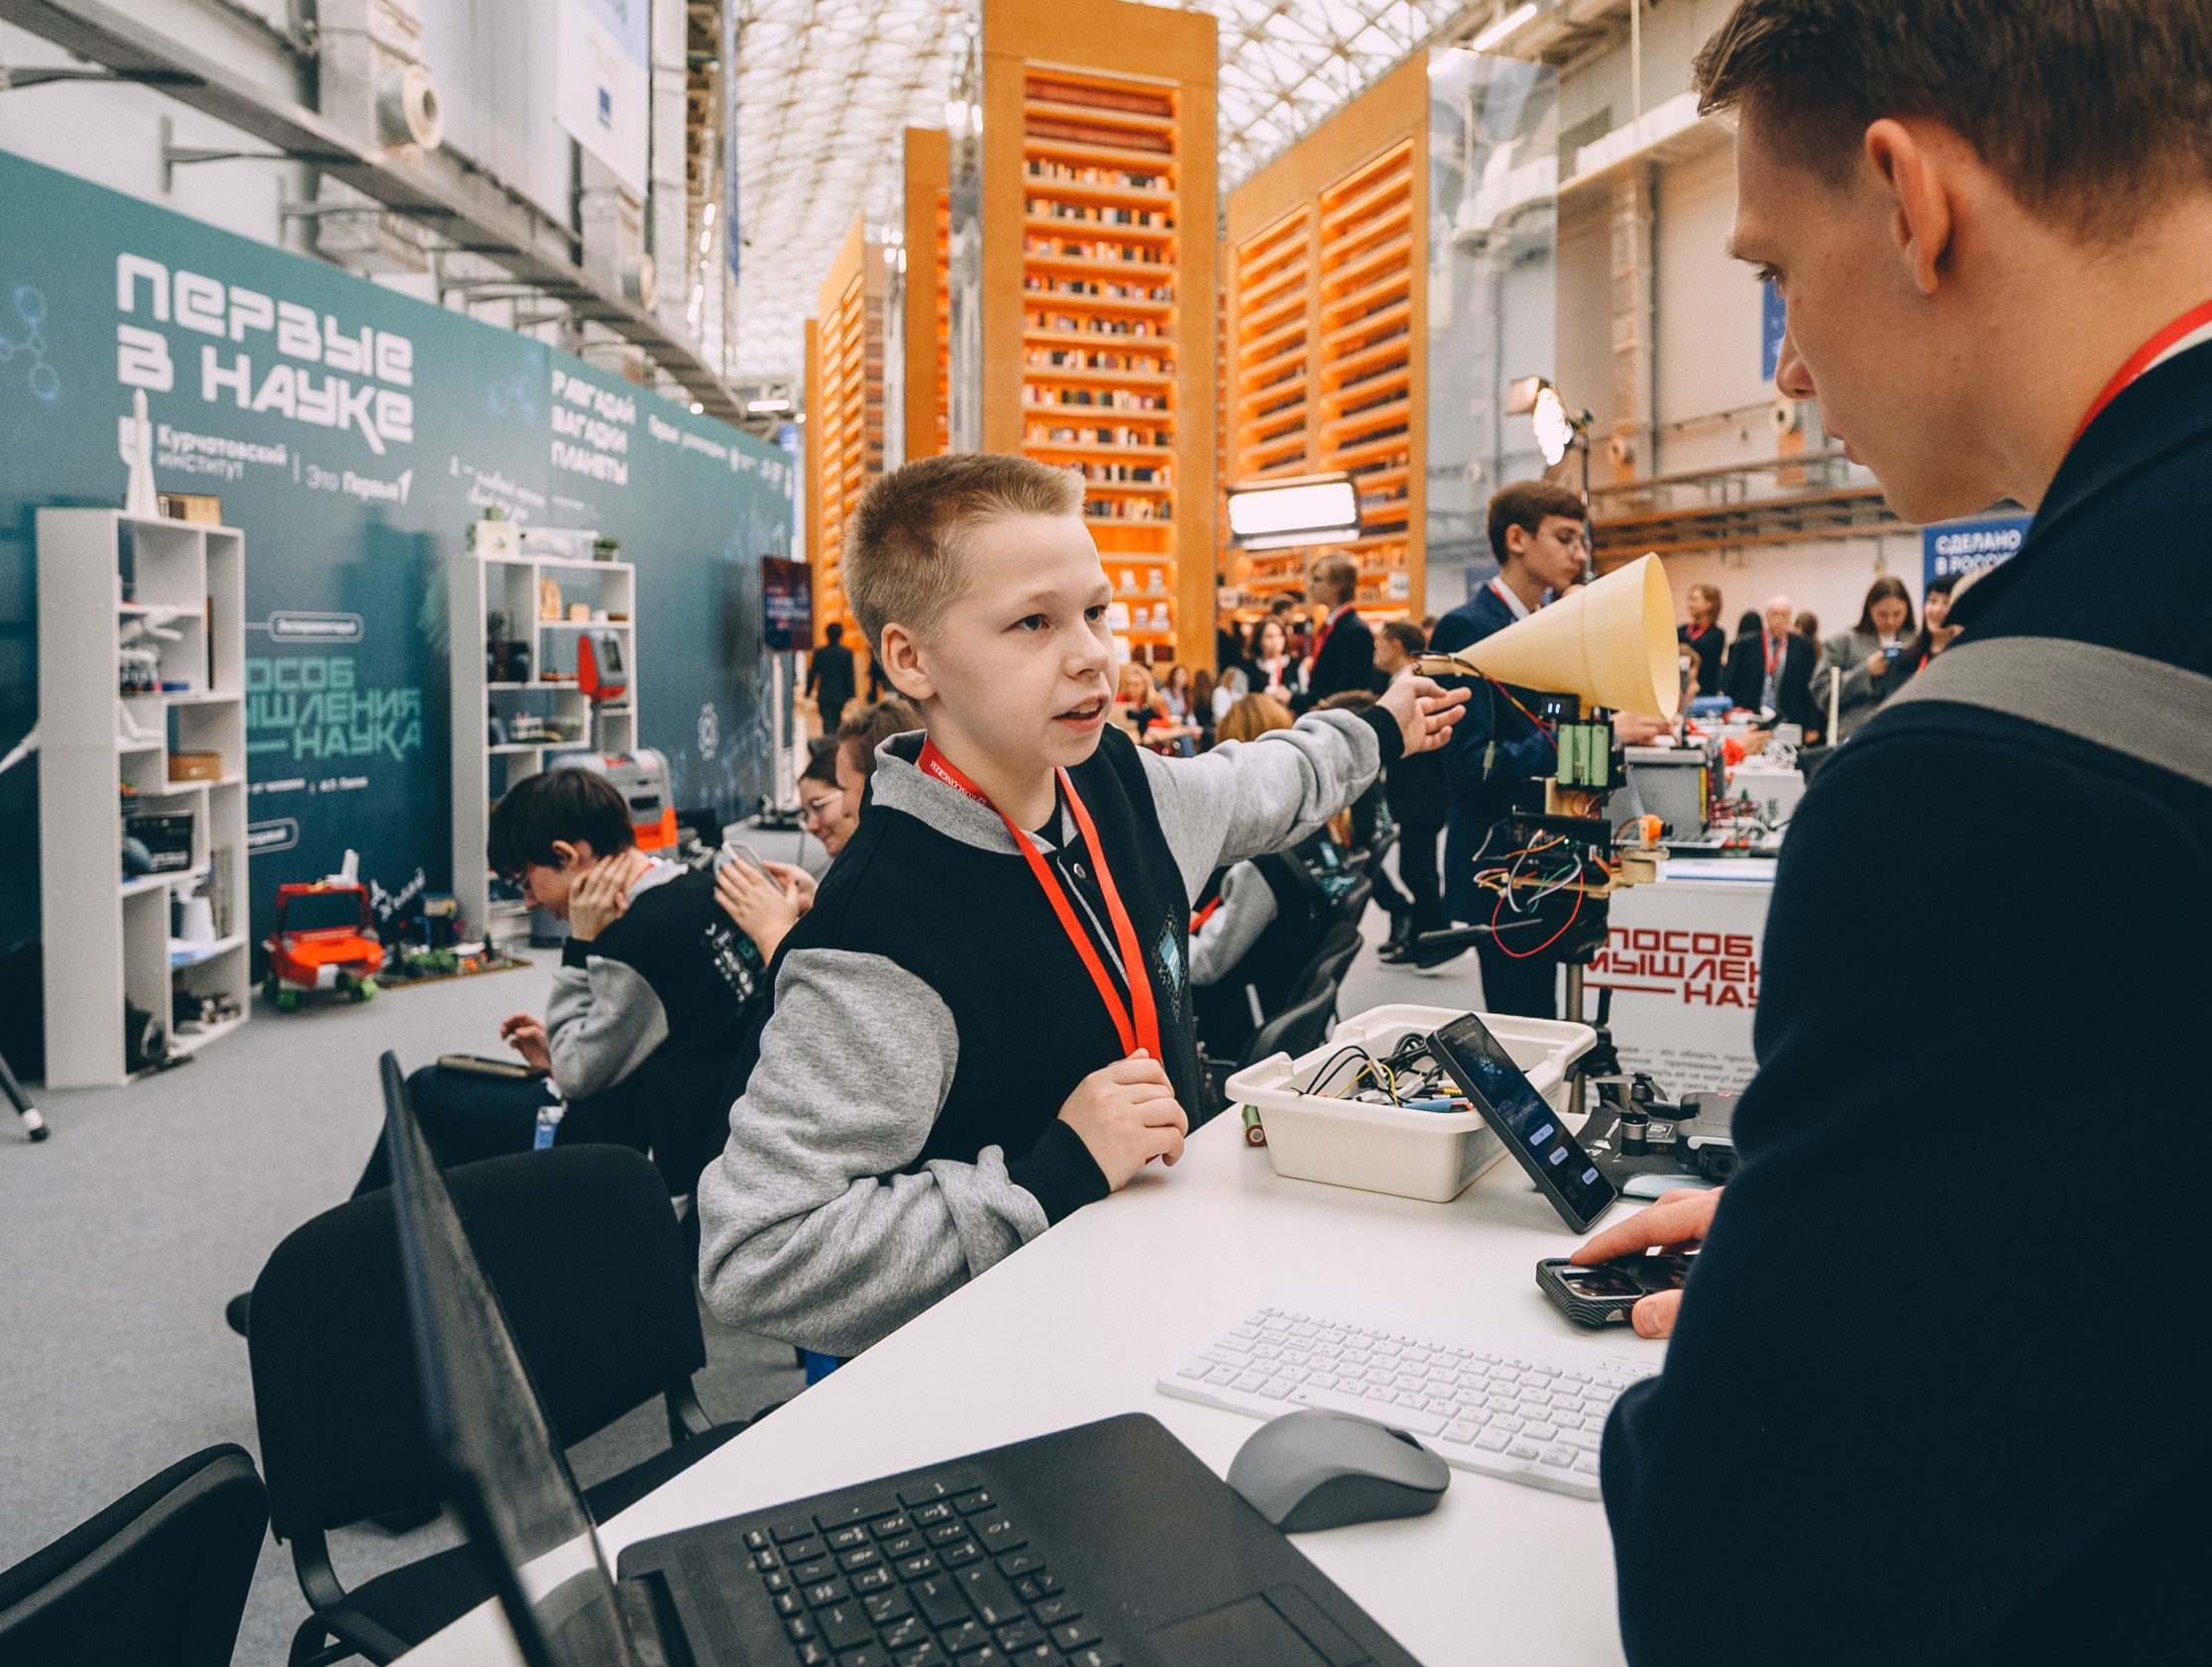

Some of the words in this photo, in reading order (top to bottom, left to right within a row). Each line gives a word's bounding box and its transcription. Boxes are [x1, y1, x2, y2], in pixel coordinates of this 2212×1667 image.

[117, 323, 173, 392] В
[158, 424, 287, 466] Курчатовский
[551, 439, 628, 486] ПЛАНЕТЫ
[305, 464, 340, 493] Это
[1935, 528, 2022, 555] СДЕЛАНО
[293, 718, 423, 762] НАУКА
